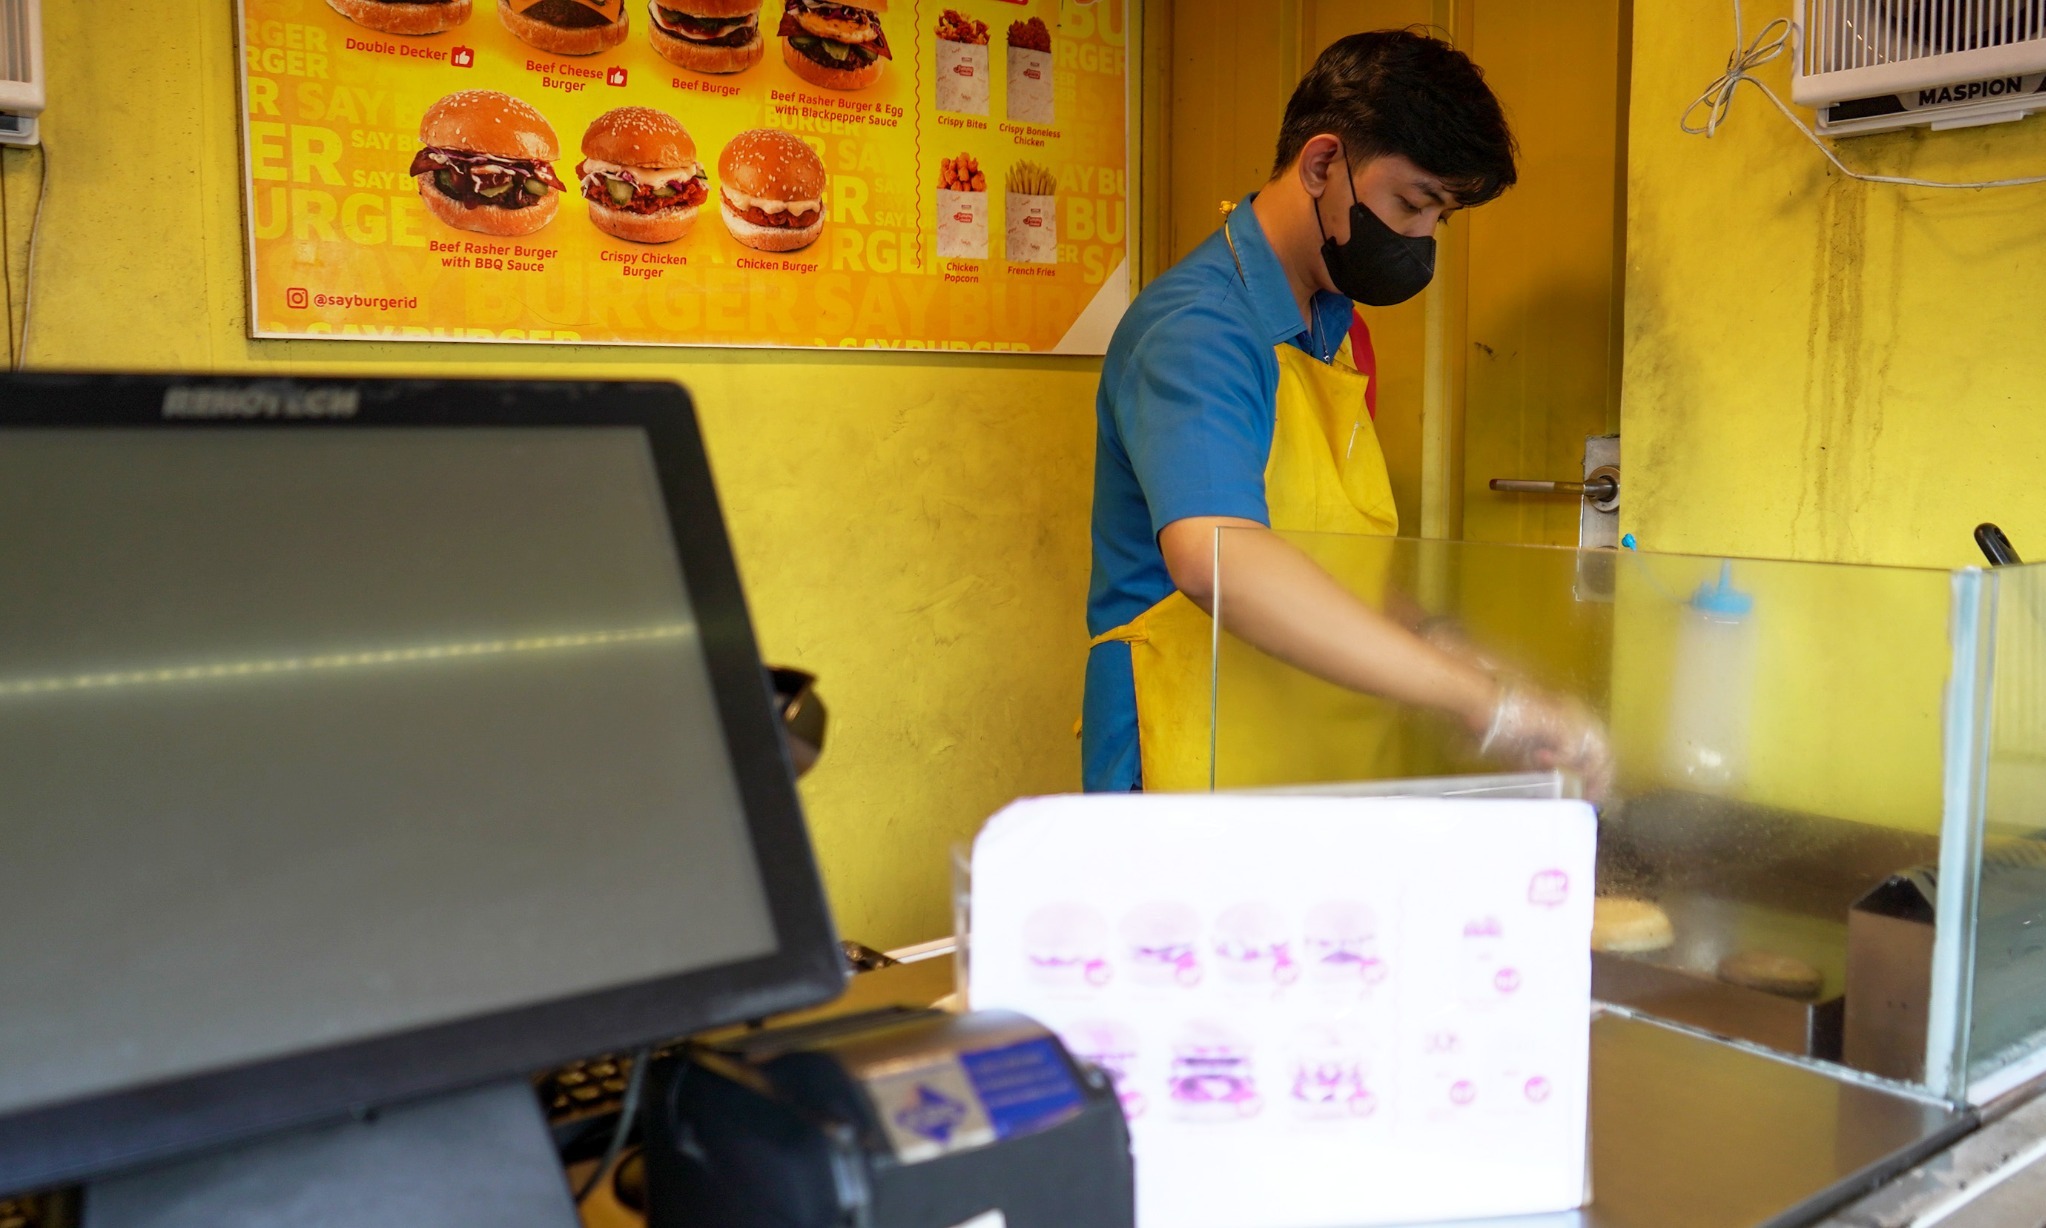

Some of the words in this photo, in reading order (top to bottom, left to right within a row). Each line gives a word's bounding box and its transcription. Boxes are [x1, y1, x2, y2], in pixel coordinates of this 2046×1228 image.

[346, 38, 395, 55] Double
[400, 45, 449, 61] Decker
[526, 60, 555, 75] Beef
[557, 63, 604, 80] Cheese
[542, 76, 587, 92] Burger
[672, 78, 698, 91] Beef
[702, 80, 741, 97] Burger
[1918, 77, 2022, 106] MASPION
[771, 90, 796, 102] Beef
[799, 93, 835, 107] Rasher
[838, 98, 873, 113] Burger
[875, 103, 882, 112] &
[885, 105, 904, 118] Egg
[775, 105, 799, 116] with
[801, 107, 866, 124] Blackpepper
[868, 115, 898, 127] Sauce
[938, 115, 964, 129] Crispy
[966, 119, 987, 130] Bites
[999, 123, 1024, 135] Crispy
[1026, 126, 1061, 139] Boneless
[351, 129, 394, 150] SAY
[1014, 136, 1045, 147] Chicken
[352, 169, 395, 190] SAY
[429, 240, 461, 253] Beef
[464, 242, 510, 256] Rasher
[514, 245, 558, 260] Burger
[600, 250, 638, 264] Crispy
[641, 252, 687, 265] Chicken
[441, 256, 471, 268] with
[475, 257, 503, 271] BBQ
[507, 259, 545, 272] Sauce
[622, 265, 664, 279] Burger
[736, 258, 779, 270] Chicken
[782, 260, 819, 274] Burger
[946, 262, 979, 273] Chicken
[1007, 266, 1035, 276] French
[1036, 267, 1056, 277] Fries
[944, 273, 979, 284] Popcorn
[314, 293, 417, 311] @sayburgerid
